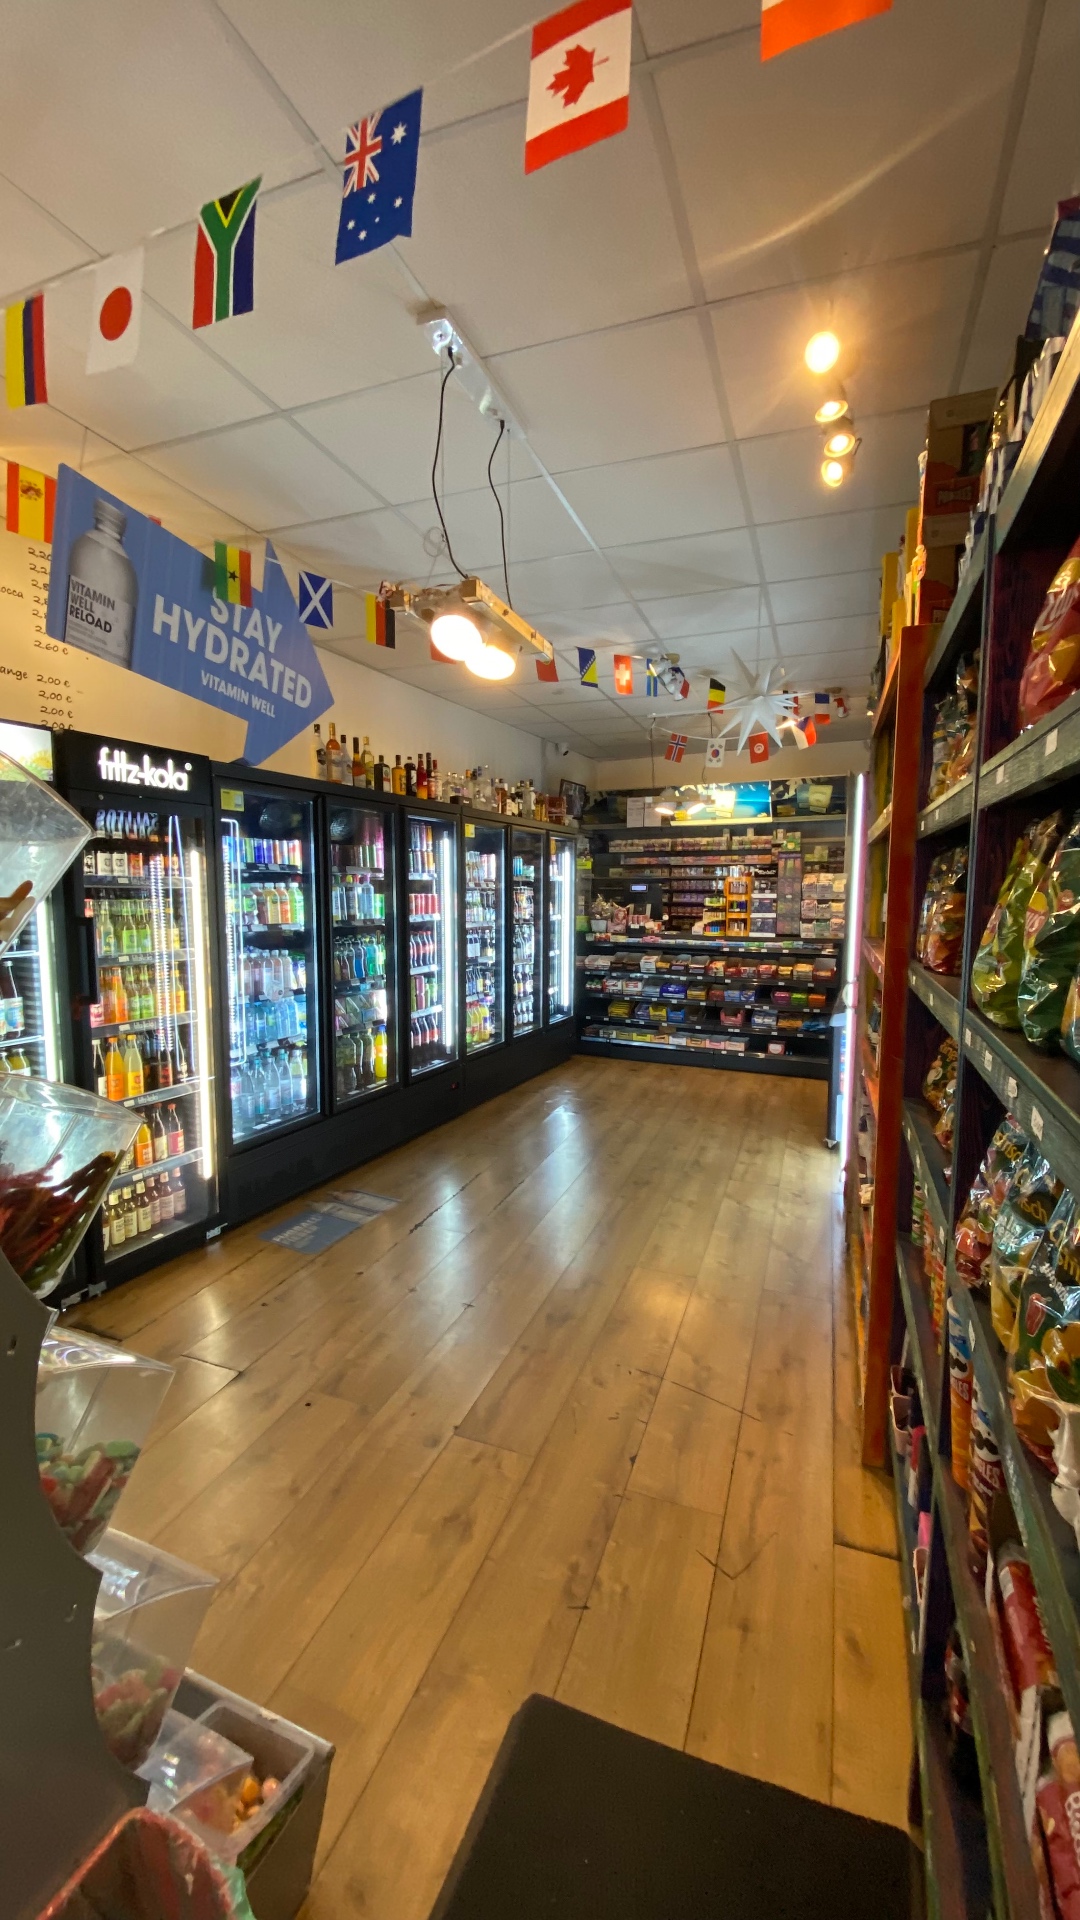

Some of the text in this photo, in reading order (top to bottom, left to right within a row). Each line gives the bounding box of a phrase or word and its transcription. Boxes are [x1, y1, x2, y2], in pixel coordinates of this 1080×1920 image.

[29, 563, 50, 575] 2,2
[0, 586, 24, 599] occa
[31, 579, 49, 592] 2,8
[70, 579, 116, 611] VITAMIN
[70, 591, 95, 614] WELL
[69, 604, 113, 634] RELOAD
[210, 586, 283, 654] STAY
[152, 593, 312, 709] HYDRATED
[38, 690, 63, 701] 2,00
[201, 669, 276, 719] VITAMIN WELL
[98, 746, 189, 791] fritz-kola
